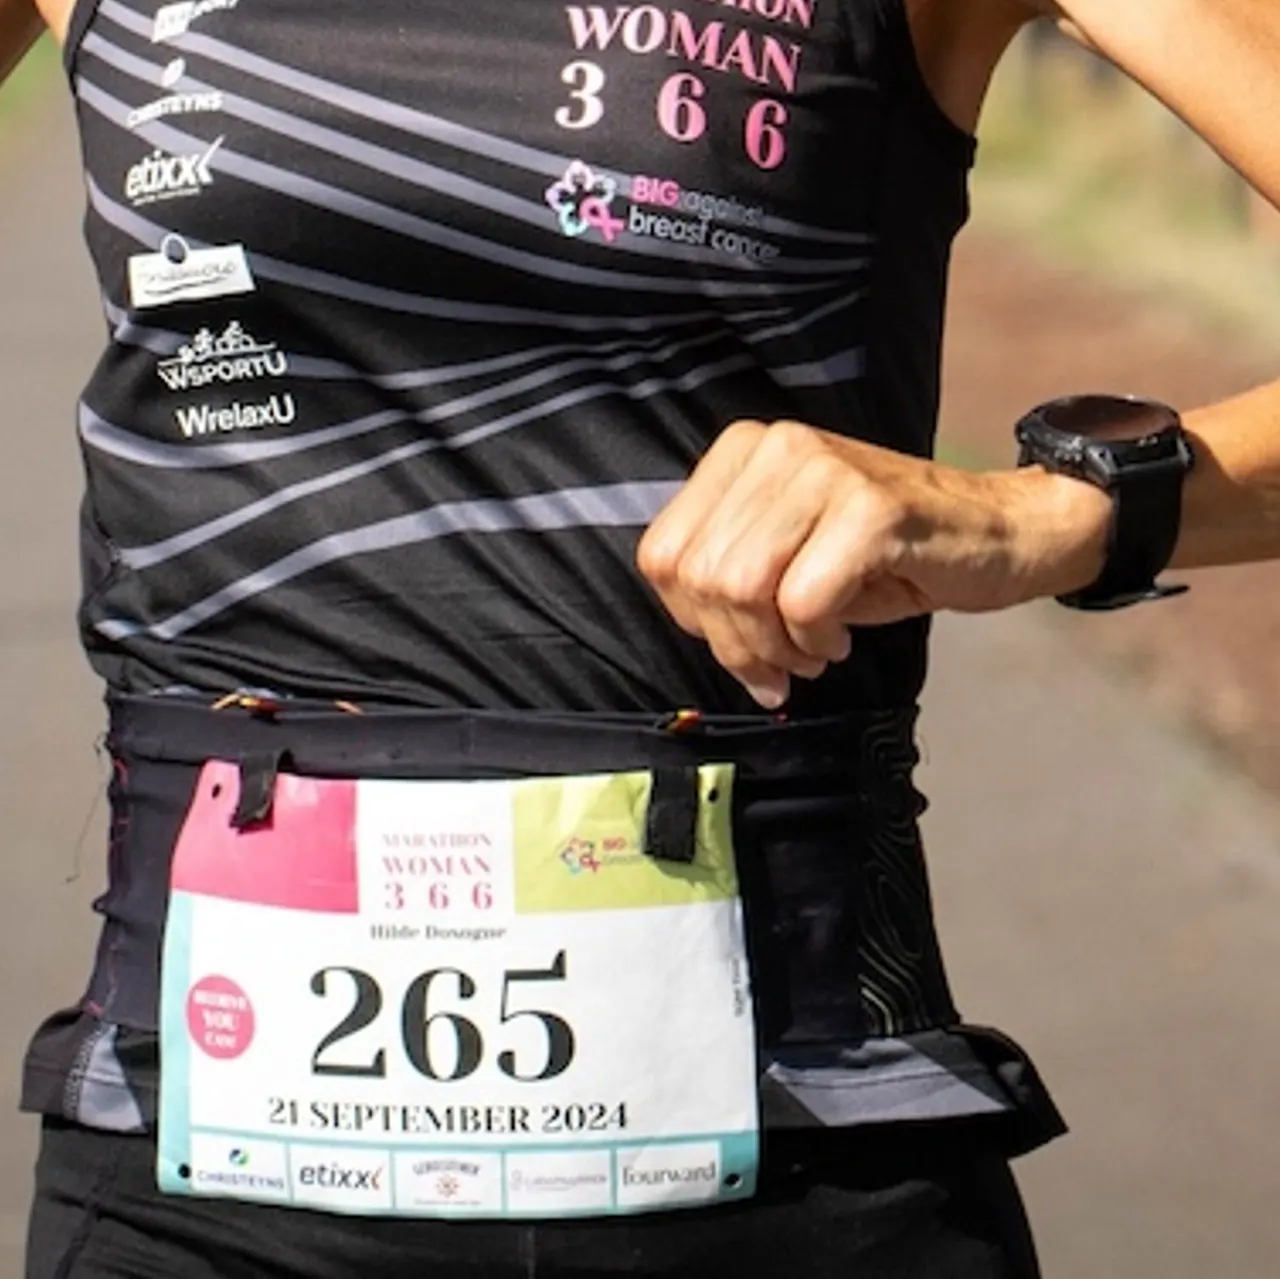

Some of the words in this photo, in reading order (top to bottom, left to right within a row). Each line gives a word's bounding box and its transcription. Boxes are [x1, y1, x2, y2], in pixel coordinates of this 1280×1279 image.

[565, 4, 801, 94] WOMAN
[554, 60, 605, 129] 3
[656, 72, 707, 142] 6
[745, 98, 788, 170] 6
[631, 174, 680, 206] BIG
[628, 204, 709, 245] breast
[157, 351, 288, 391] WSPORTU
[176, 393, 295, 438] WrelaxU
[381, 853, 493, 877] WOMAN
[383, 881, 405, 911] 3
[428, 881, 450, 911] 6
[472, 881, 494, 911] 6
[370, 923, 420, 940] Hilde
[308, 949, 577, 1084] 265
[269, 1097, 299, 1127] 21
[309, 1100, 530, 1135] SEPTEMBER
[541, 1100, 629, 1134] 2024
[298, 1163, 373, 1190] etixx
